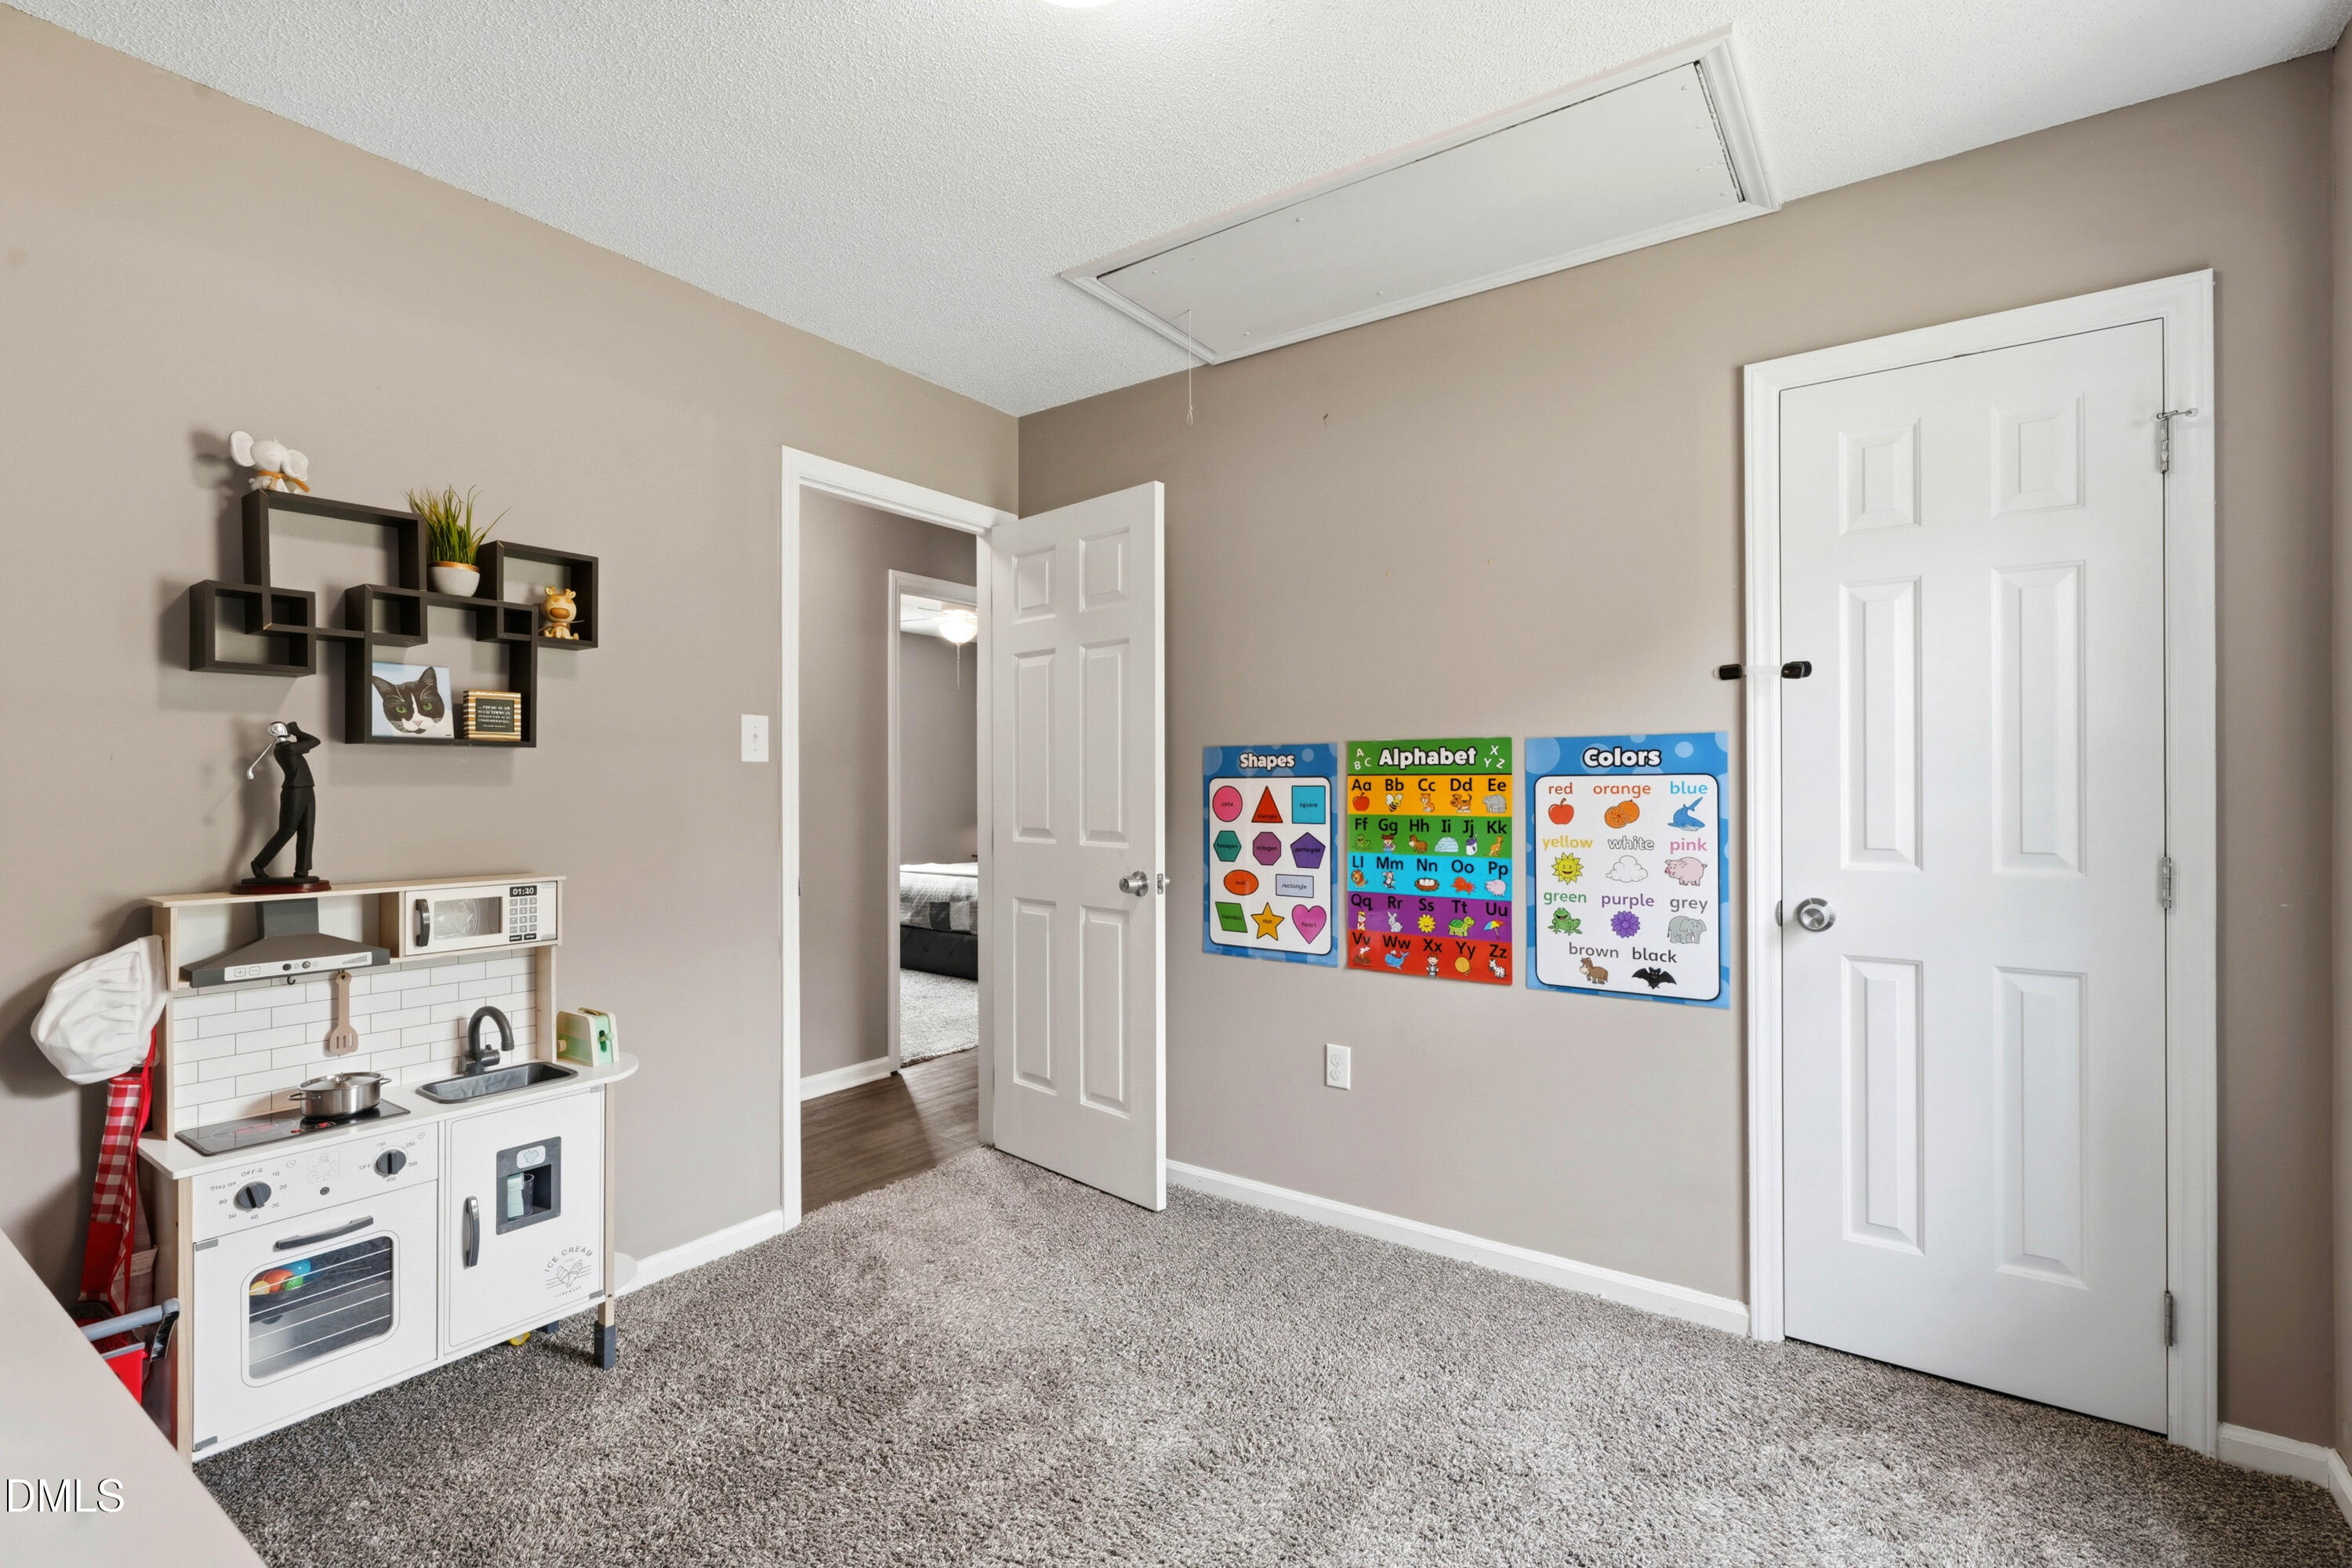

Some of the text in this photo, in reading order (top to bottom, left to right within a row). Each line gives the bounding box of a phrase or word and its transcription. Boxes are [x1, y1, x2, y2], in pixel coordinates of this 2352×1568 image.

[1356, 748, 1364, 757] A
[1377, 746, 1478, 770] Alphabet
[1490, 745, 1499, 756] X
[1583, 746, 1662, 768] Colors
[1239, 752, 1295, 771] Shapes
[1354, 760, 1361, 770] B
[1364, 757, 1371, 767] C
[1483, 757, 1492, 768] Y
[1496, 758, 1505, 769] Z
[1351, 777, 1507, 792] Aa Bb Cc Dd Ee
[1548, 781, 1708, 798] red orange blue
[1355, 817, 1507, 838] Ff Gg Hh Ii Jj Kk
[1542, 835, 1708, 855] yellow white pink
[1352, 855, 1508, 880] Ll Mm Nn Oo Pp
[513, 887, 534, 895] 01:30
[1282, 883, 1307, 891] rectangle
[1351, 893, 1508, 916] Qq Rr Ss Tt Uu
[1544, 891, 1708, 913] green purple grey
[1352, 931, 1508, 960] Vv Ww Xx Yy Zz
[1569, 942, 1677, 963] brown black
[544, 1255, 559, 1272] ICE
[561, 1245, 593, 1258] CREAM
